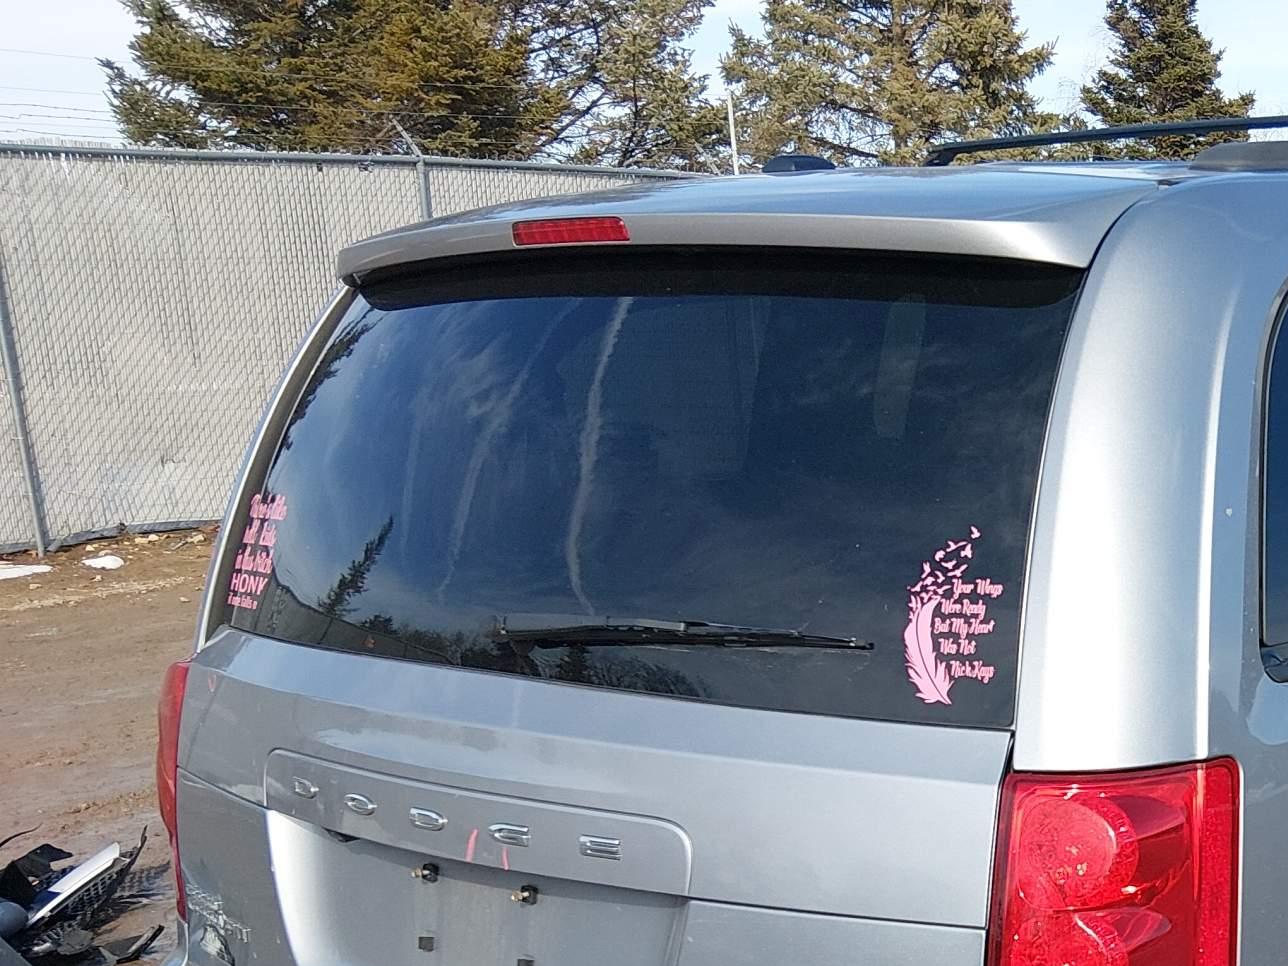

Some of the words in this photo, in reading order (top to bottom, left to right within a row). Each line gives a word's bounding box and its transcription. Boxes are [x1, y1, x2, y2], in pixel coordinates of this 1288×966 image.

[952, 578, 975, 599] Your
[976, 578, 1004, 598] Wings
[940, 598, 962, 615] Were
[962, 599, 987, 620] Ready
[950, 618, 968, 639] My
[969, 619, 996, 635] Heart
[958, 638, 977, 655] Not
[292, 776, 622, 861] DODGE
